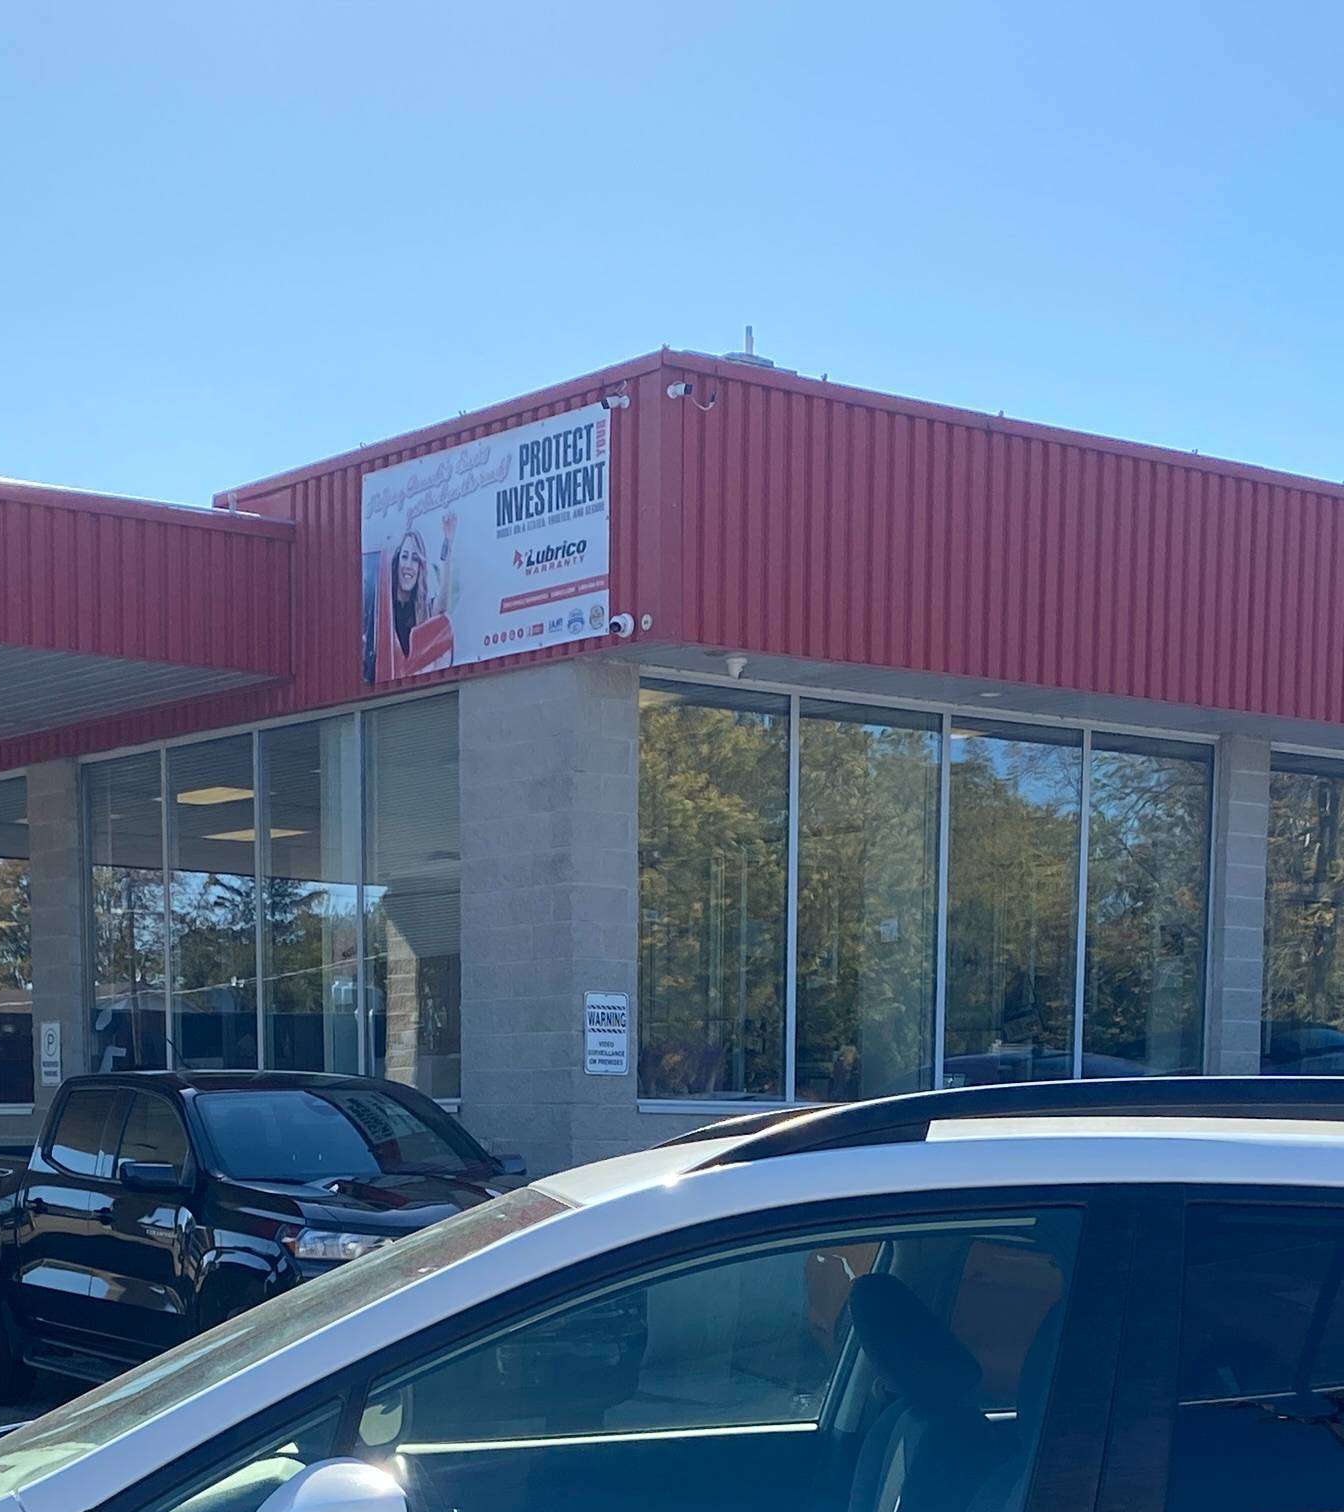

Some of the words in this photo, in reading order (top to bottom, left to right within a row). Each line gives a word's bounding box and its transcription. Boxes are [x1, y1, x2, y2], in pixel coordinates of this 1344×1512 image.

[519, 423, 594, 481] PROTECT
[596, 419, 606, 458] YOUR
[496, 461, 606, 527] INVESTMENT
[525, 555, 585, 576] WARRANTY
[526, 539, 587, 568] Lubrico
[587, 1011, 626, 1028] WARNING
